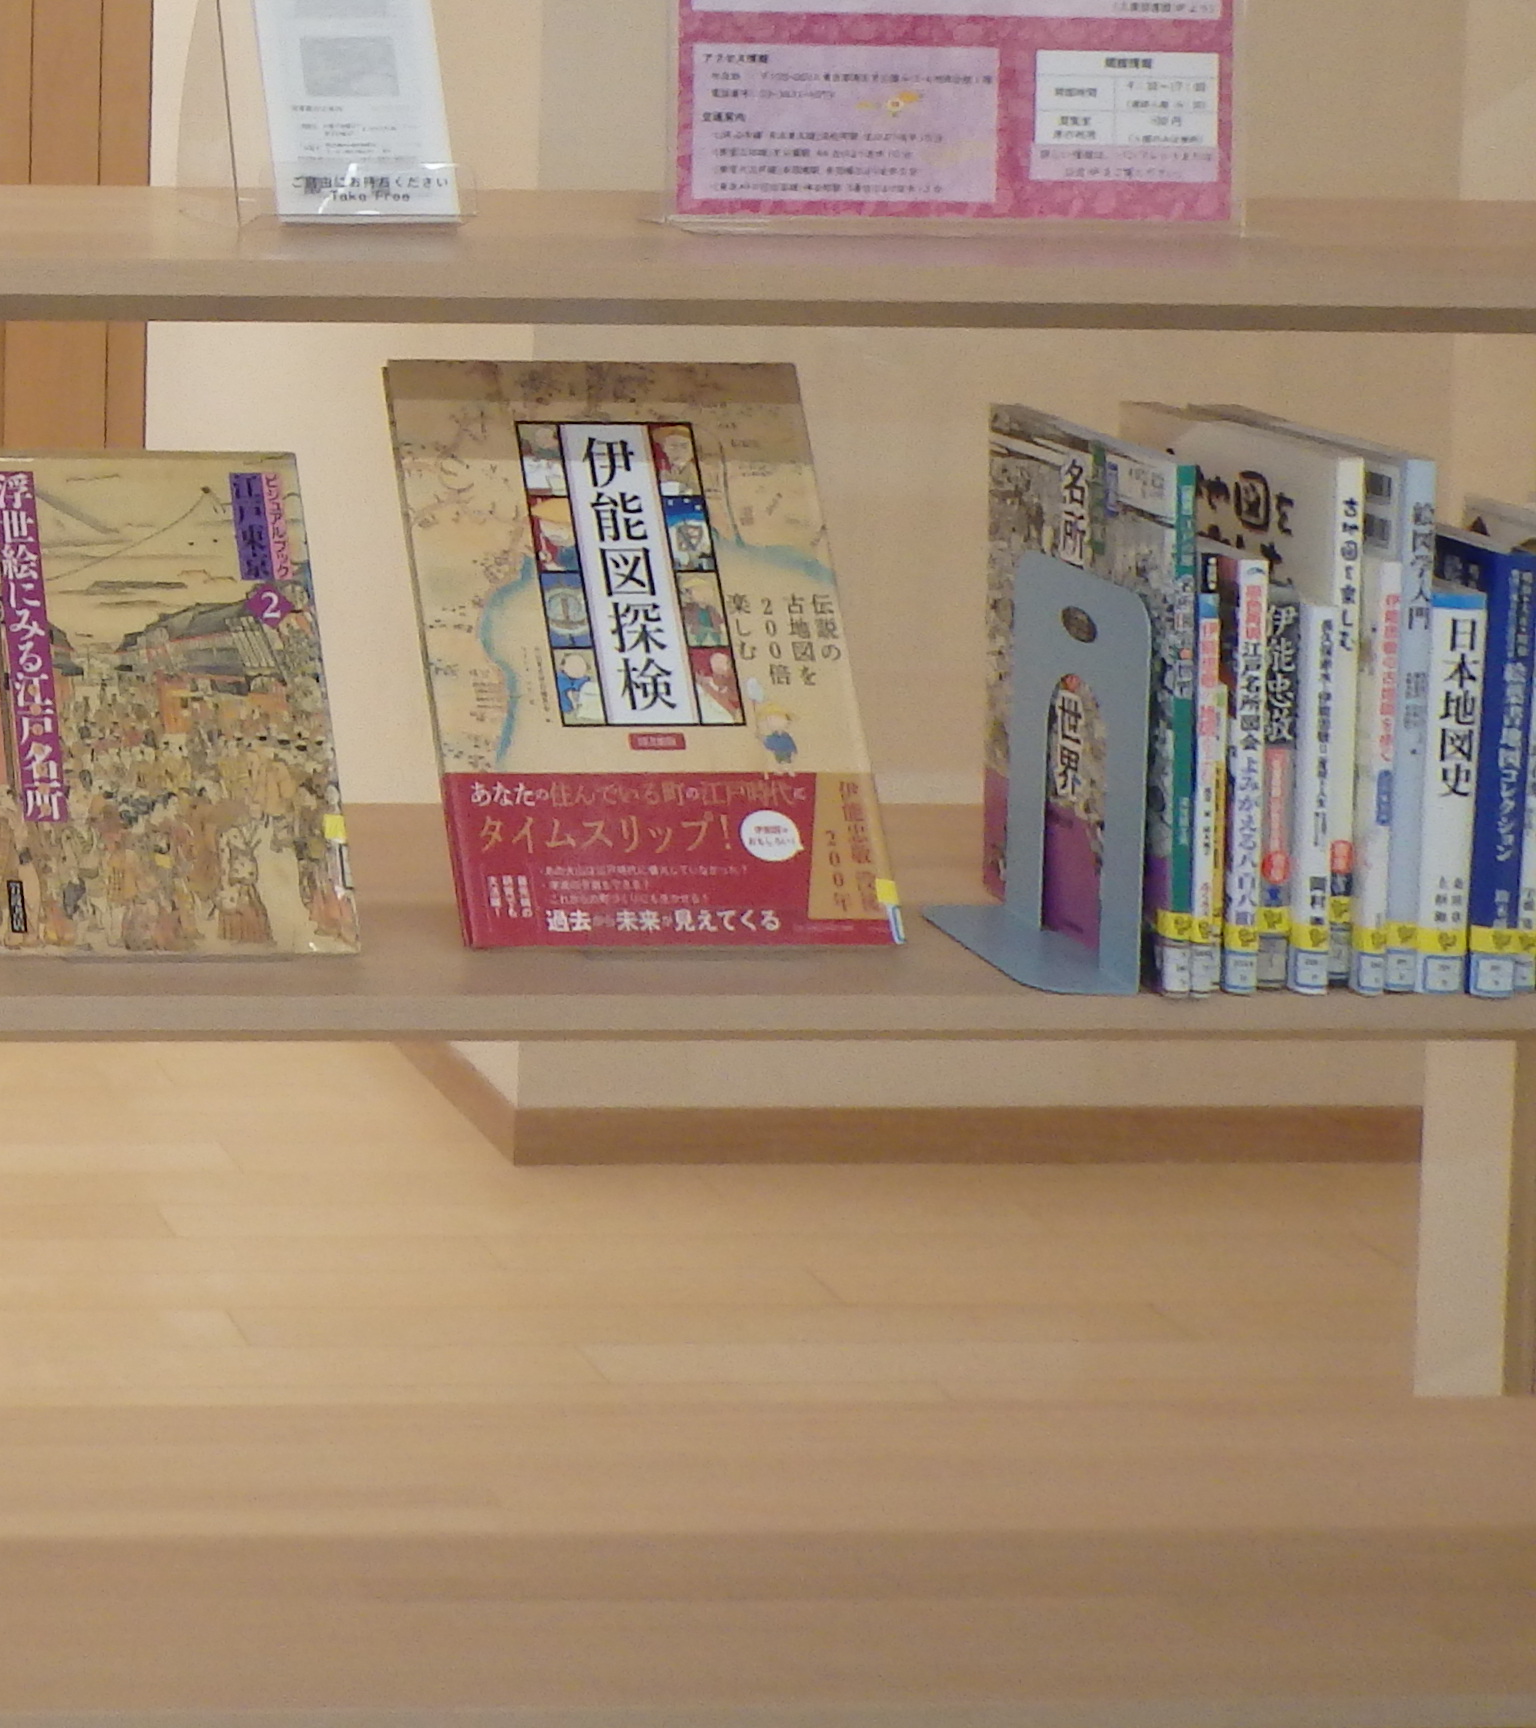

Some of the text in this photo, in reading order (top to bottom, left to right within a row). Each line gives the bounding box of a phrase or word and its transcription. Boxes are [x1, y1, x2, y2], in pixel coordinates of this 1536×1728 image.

[331, 189, 411, 202] Take Free
[232, 474, 270, 579] 江戸東京
[265, 473, 290, 579] ビジュアルブック
[260, 591, 282, 619] 2
[581, 436, 678, 712] 伊能図探検
[727, 592, 756, 660] 楽しむ
[760, 598, 792, 685] 200倍
[785, 593, 817, 686] 古地図を
[811, 593, 842, 660] 伝説の
[1239, 641, 1263, 751] 江戸名所図会
[1266, 605, 1298, 744] 伊能忠敬
[1439, 617, 1477, 798] 日本地図史
[1054, 687, 1083, 797] 世界
[469, 780, 807, 808] あなたの住んでいる町の江戸時代に
[546, 908, 781, 933] 過去から未来が見えてくる
